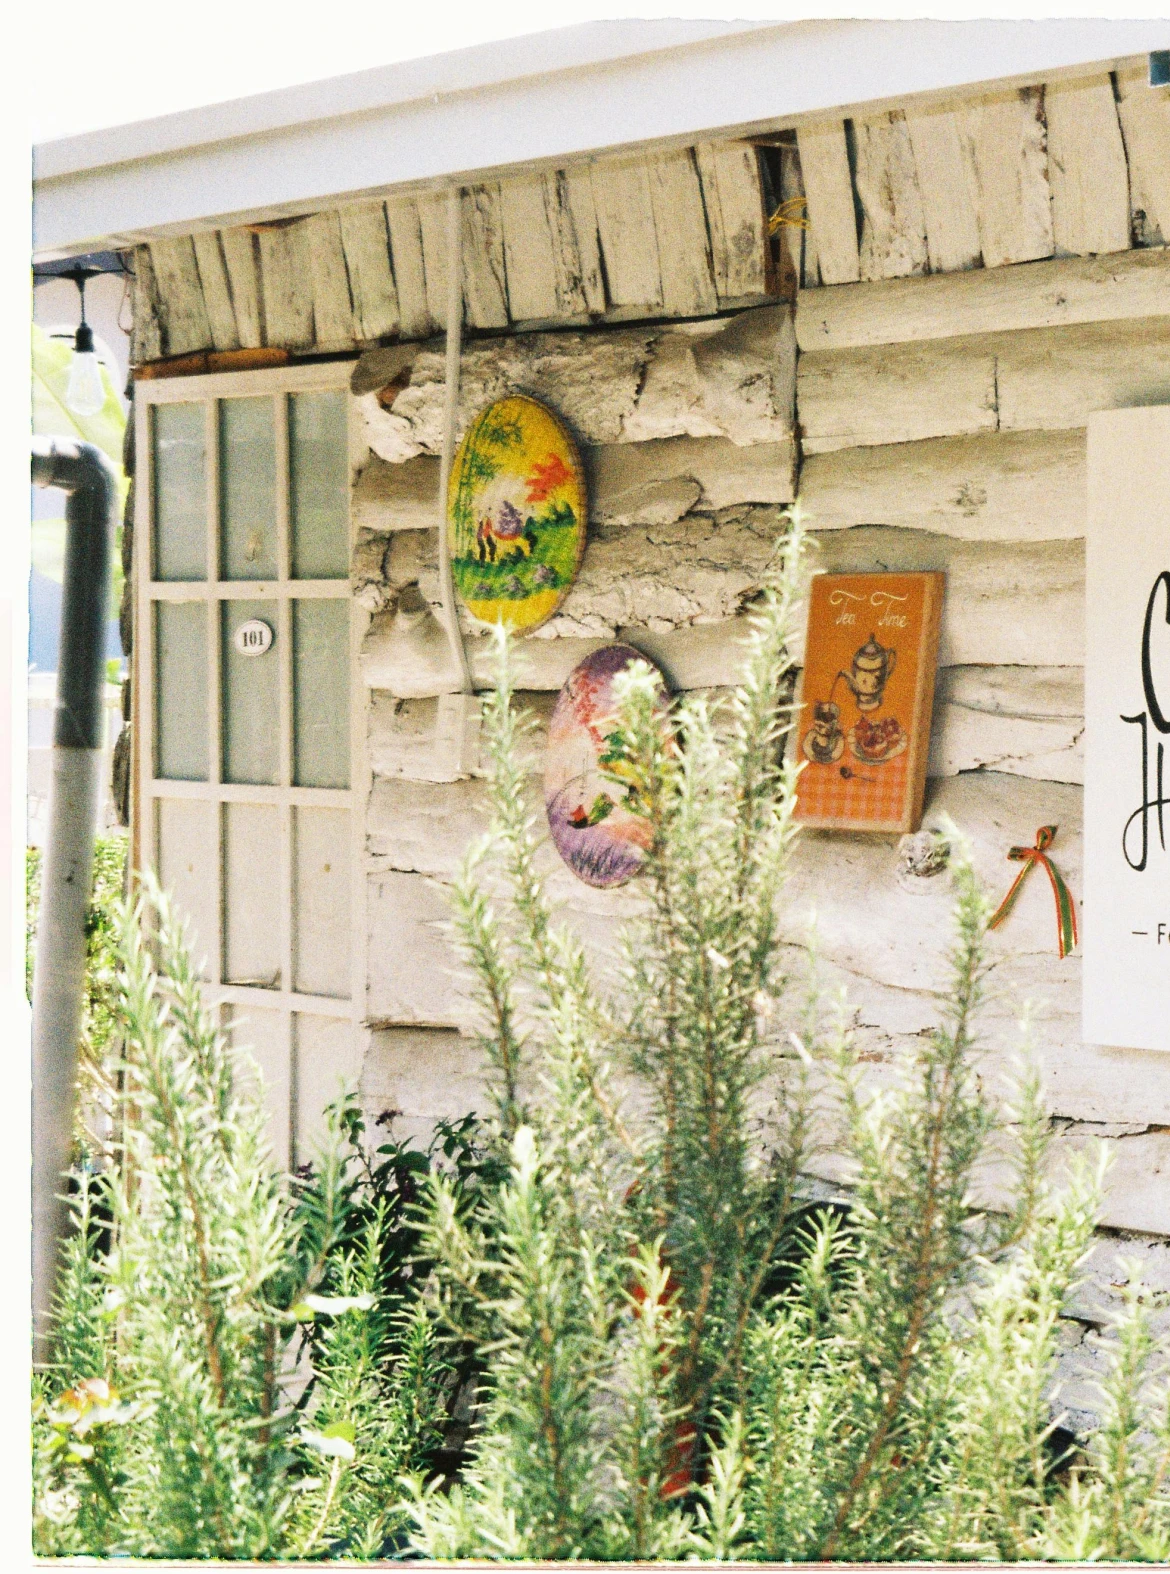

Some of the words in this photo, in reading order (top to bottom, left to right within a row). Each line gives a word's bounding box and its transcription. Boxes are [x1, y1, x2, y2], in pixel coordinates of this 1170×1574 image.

[829, 590, 866, 625] Tea
[870, 591, 909, 627] Time
[242, 631, 264, 647] 101
